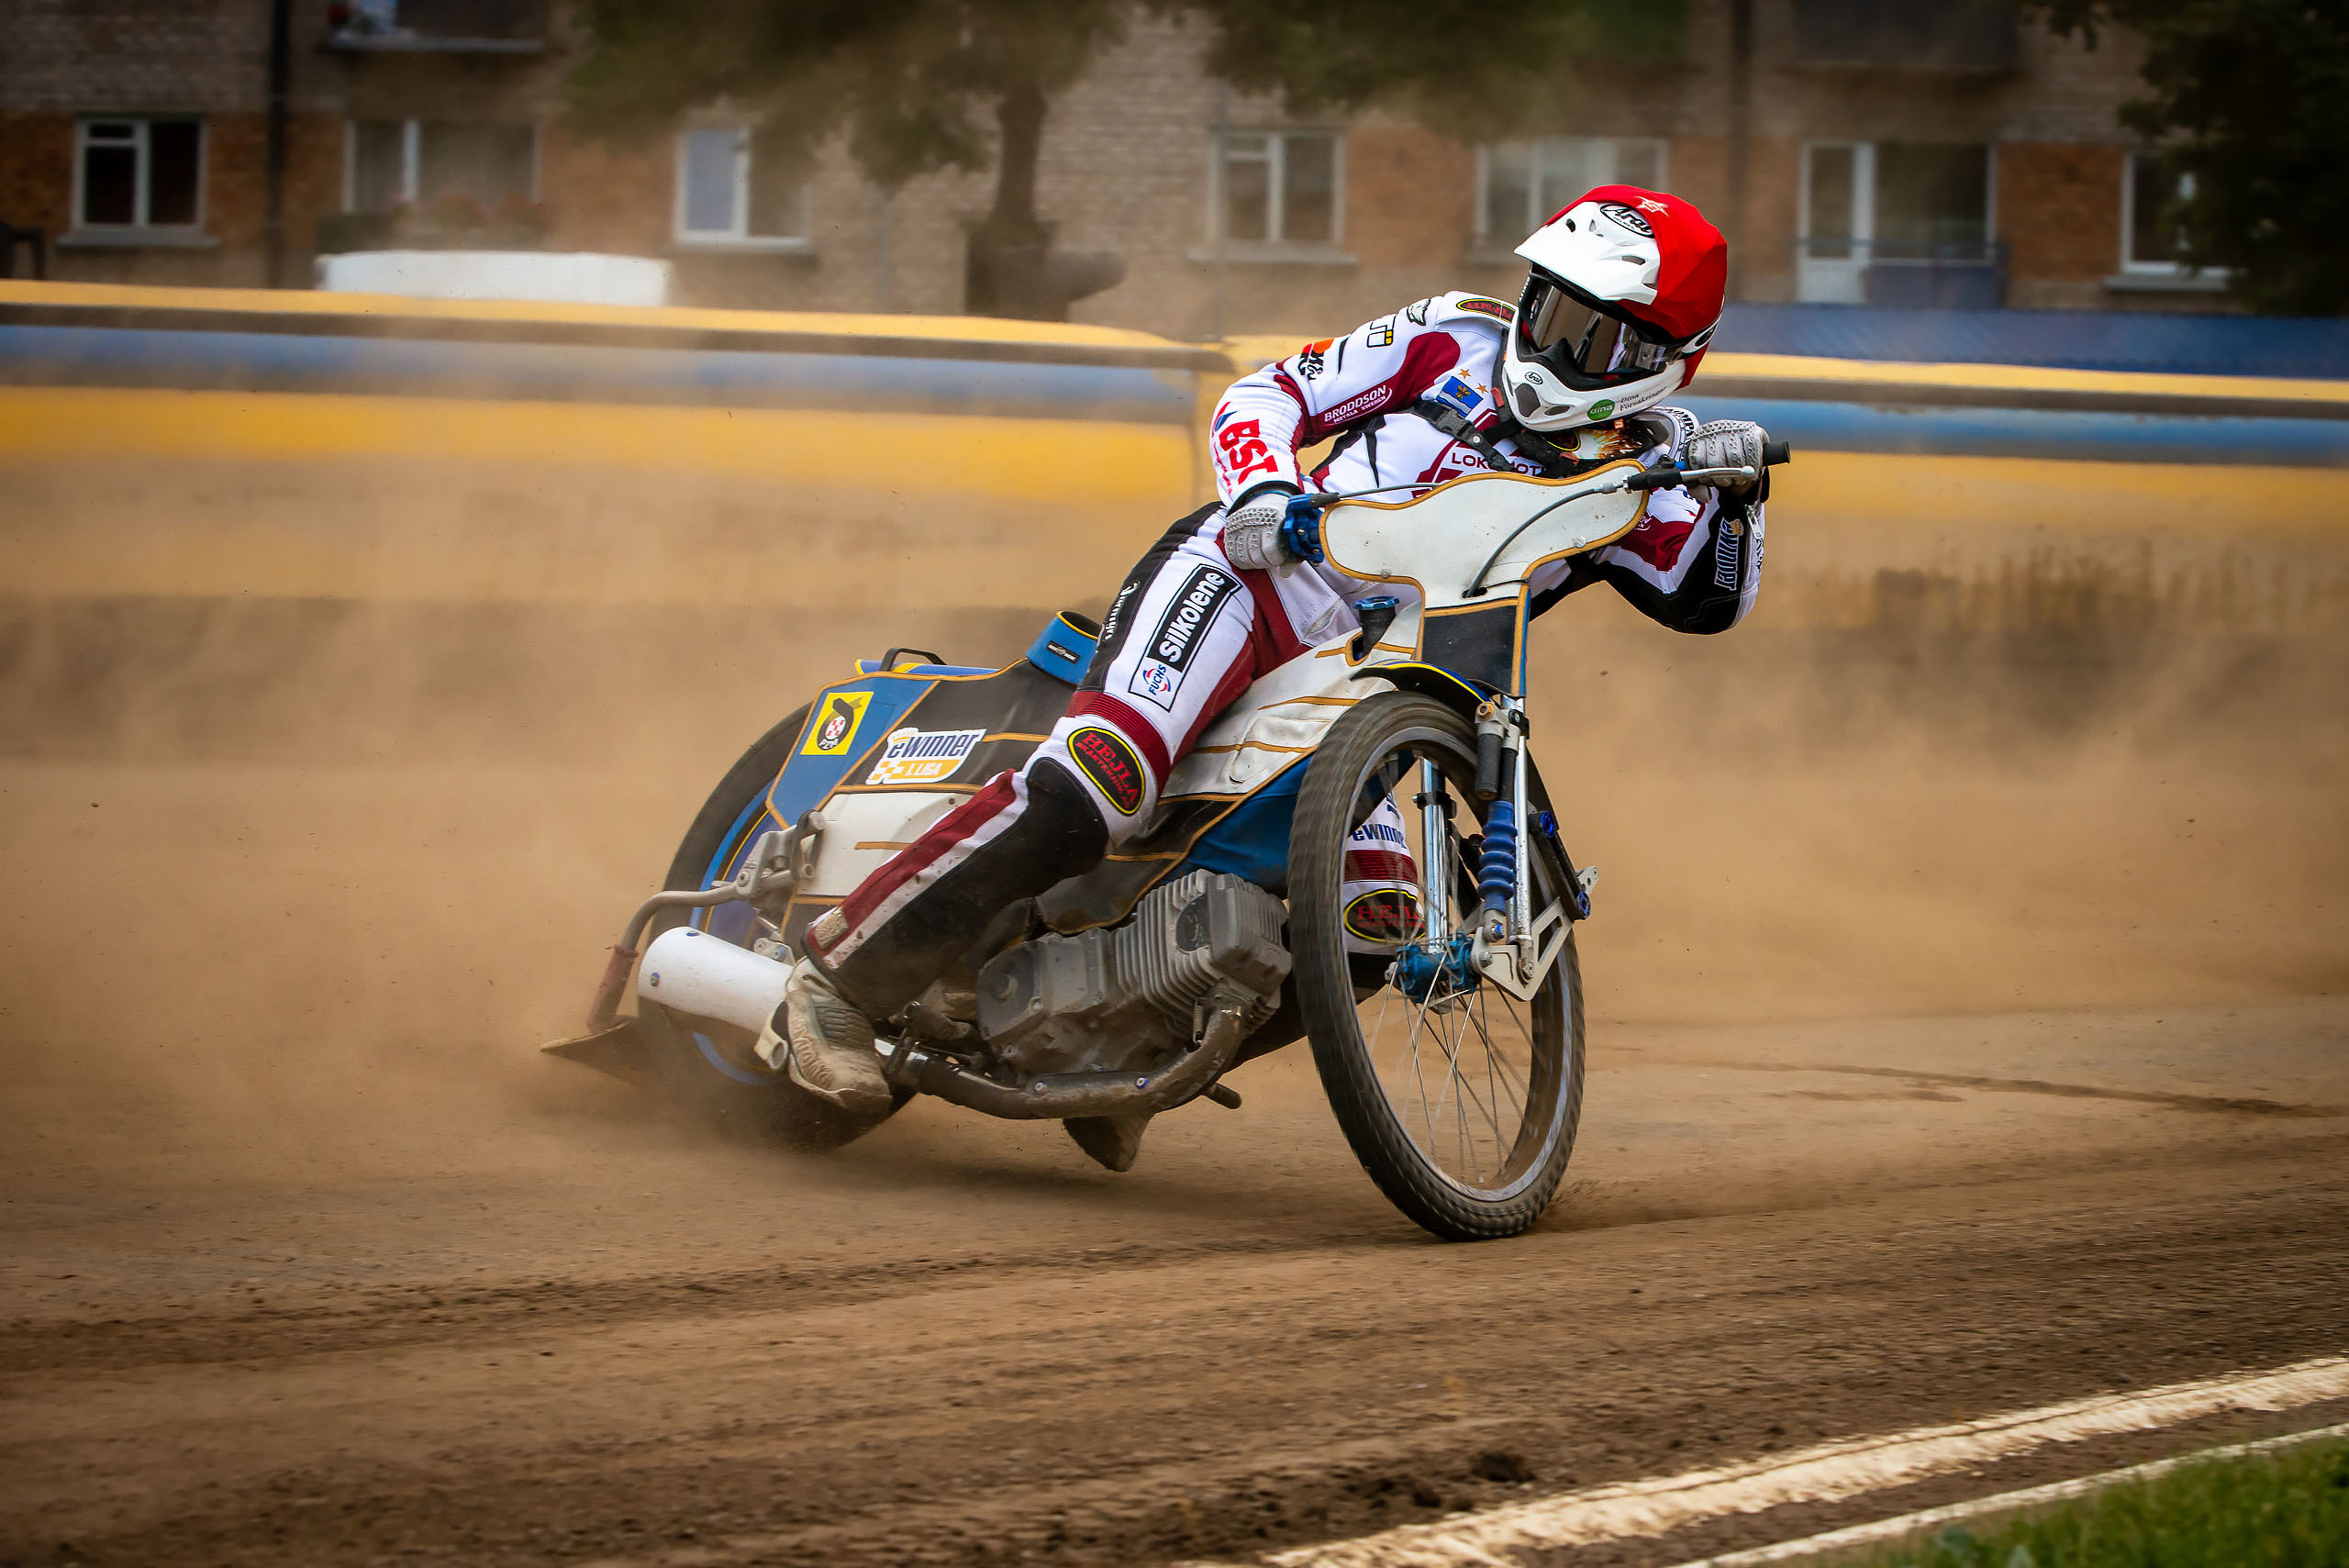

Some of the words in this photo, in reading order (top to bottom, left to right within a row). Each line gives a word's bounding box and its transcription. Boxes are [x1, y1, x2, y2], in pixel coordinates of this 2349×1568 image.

[1324, 384, 1386, 422] BRODDSON
[1333, 409, 1359, 423] MOTALA
[1361, 395, 1386, 411] SWEDEN
[1589, 405, 1613, 415] dina
[1620, 393, 1640, 404] Dina
[1219, 418, 1279, 485] BST
[1159, 572, 1226, 663] Silkolene
[1148, 663, 1167, 696] FUCHS
[914, 762, 943, 776] LIGA
[1081, 732, 1139, 804] HEJLA
